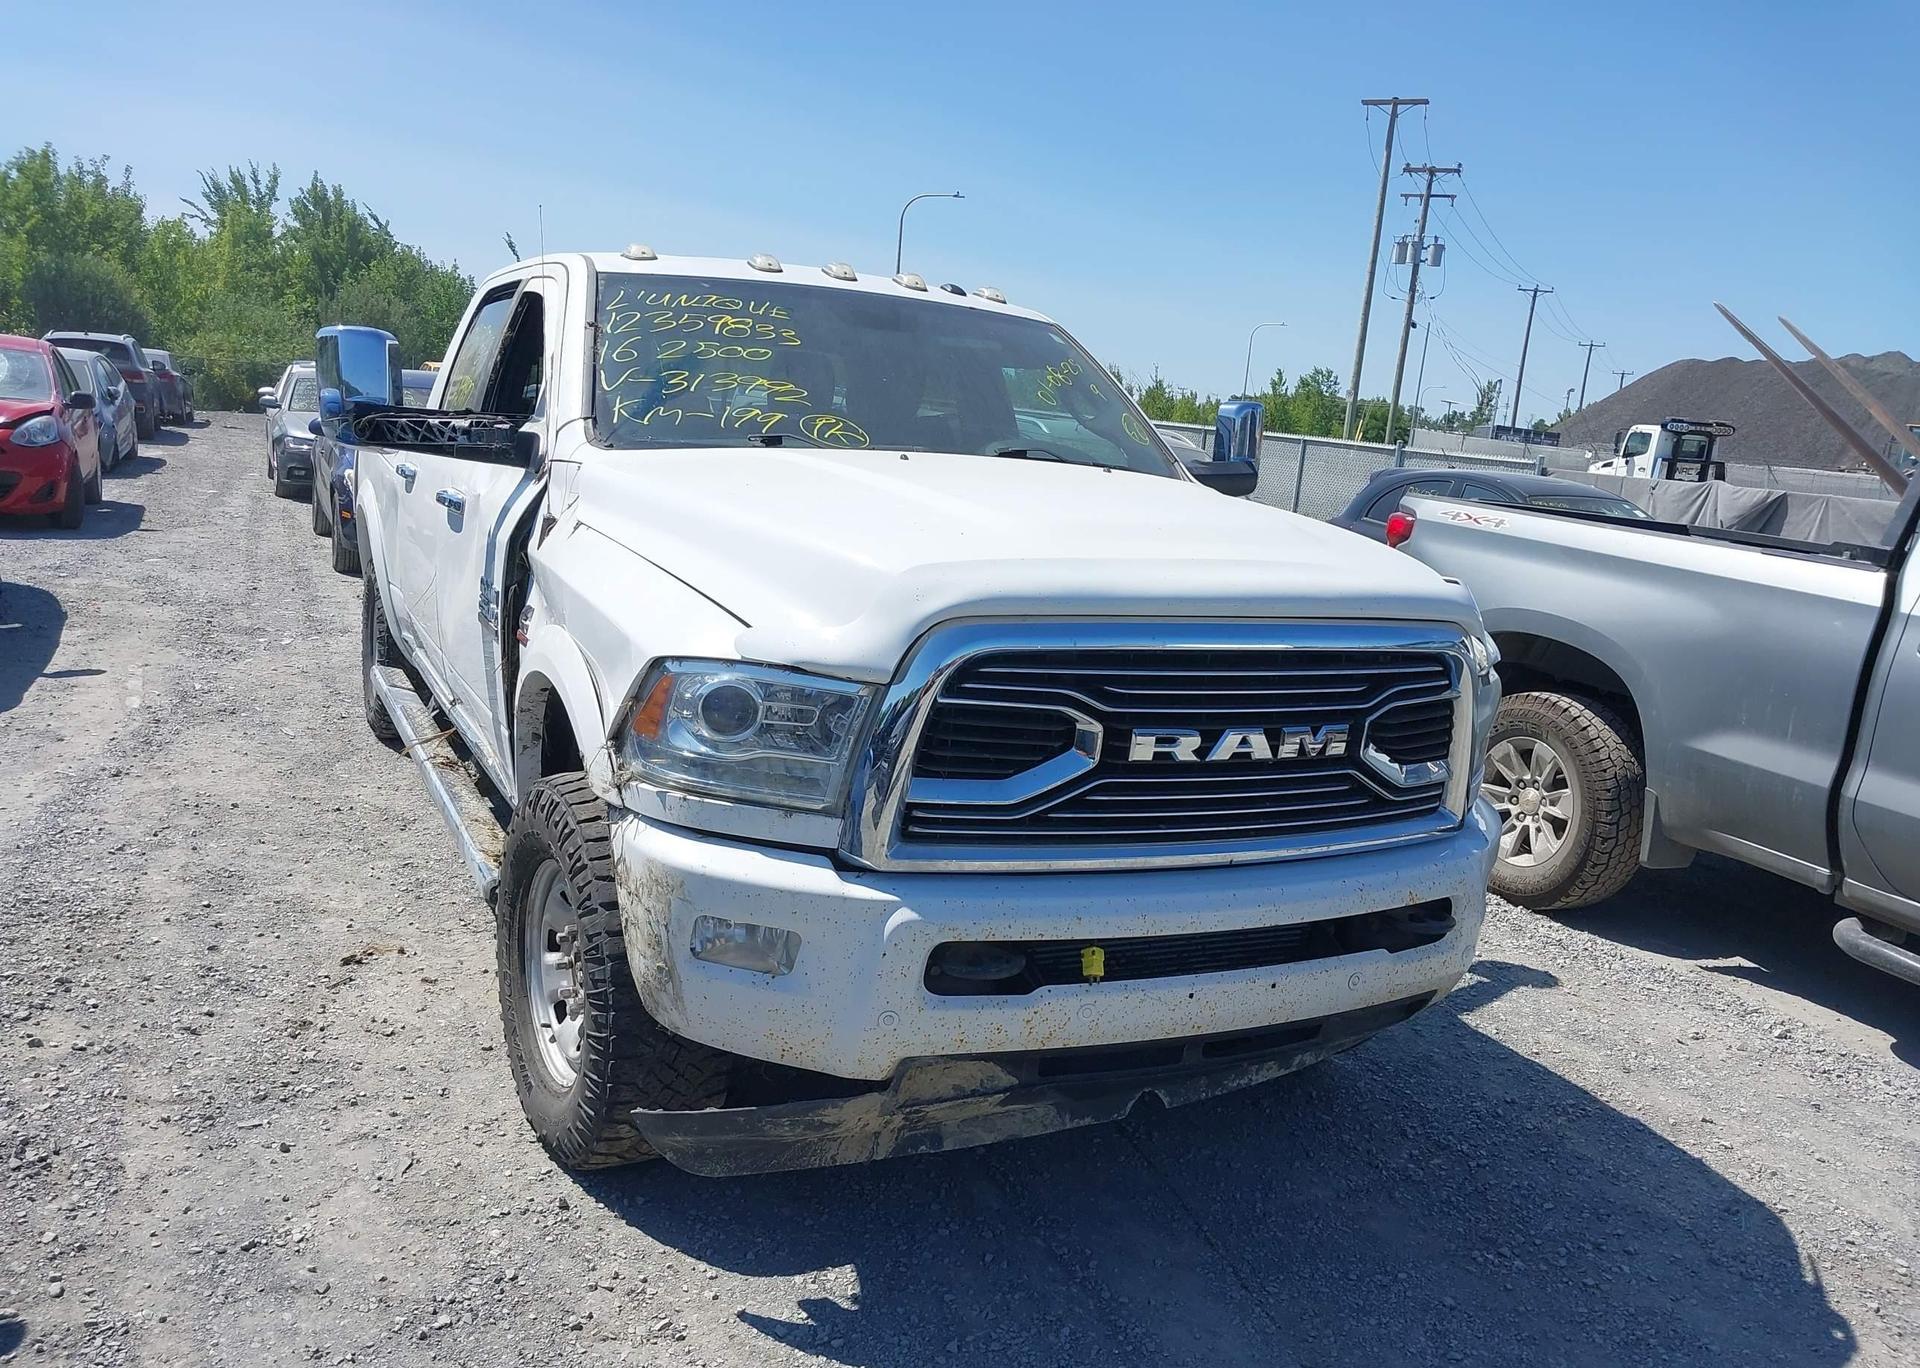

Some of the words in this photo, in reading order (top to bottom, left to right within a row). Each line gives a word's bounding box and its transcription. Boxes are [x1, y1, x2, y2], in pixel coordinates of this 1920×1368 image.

[605, 289, 792, 320] L'UNIQUE
[605, 310, 802, 347] 12359833
[598, 335, 643, 365] 16
[655, 340, 773, 361] 2500
[1128, 724, 1350, 762] RAM
